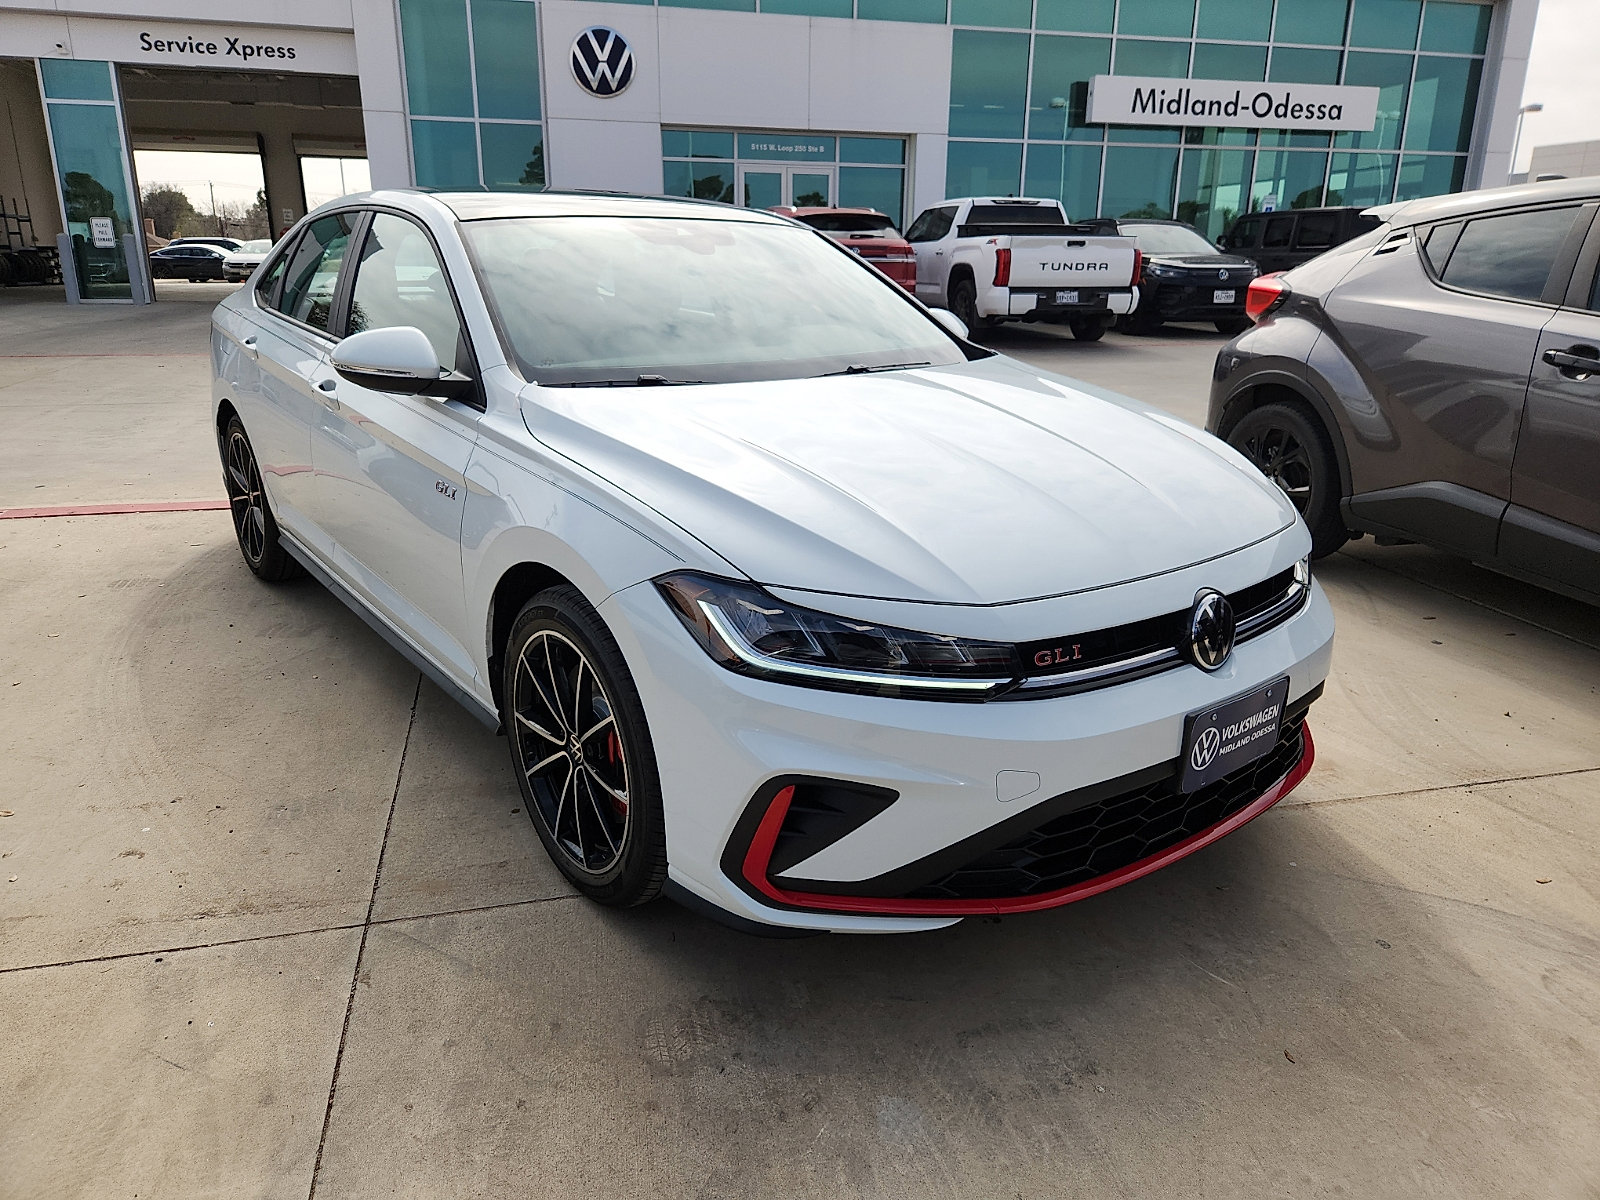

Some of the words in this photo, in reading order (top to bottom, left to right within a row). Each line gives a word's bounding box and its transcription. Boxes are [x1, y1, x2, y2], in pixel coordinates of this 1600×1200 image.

[139, 32, 218, 55] Service
[224, 37, 297, 61] Xpress
[1131, 88, 1344, 121] Midland-Odessa
[751, 143, 768, 151] 5115
[777, 144, 794, 153] Loop
[1039, 262, 1109, 271] TUNDRA
[435, 479, 458, 501] GLI
[1034, 644, 1082, 667] GLI
[1222, 703, 1280, 741] VOLKSWAGEN
[1219, 735, 1251, 756] MIDLAND
[1251, 723, 1276, 741] ODESSA
